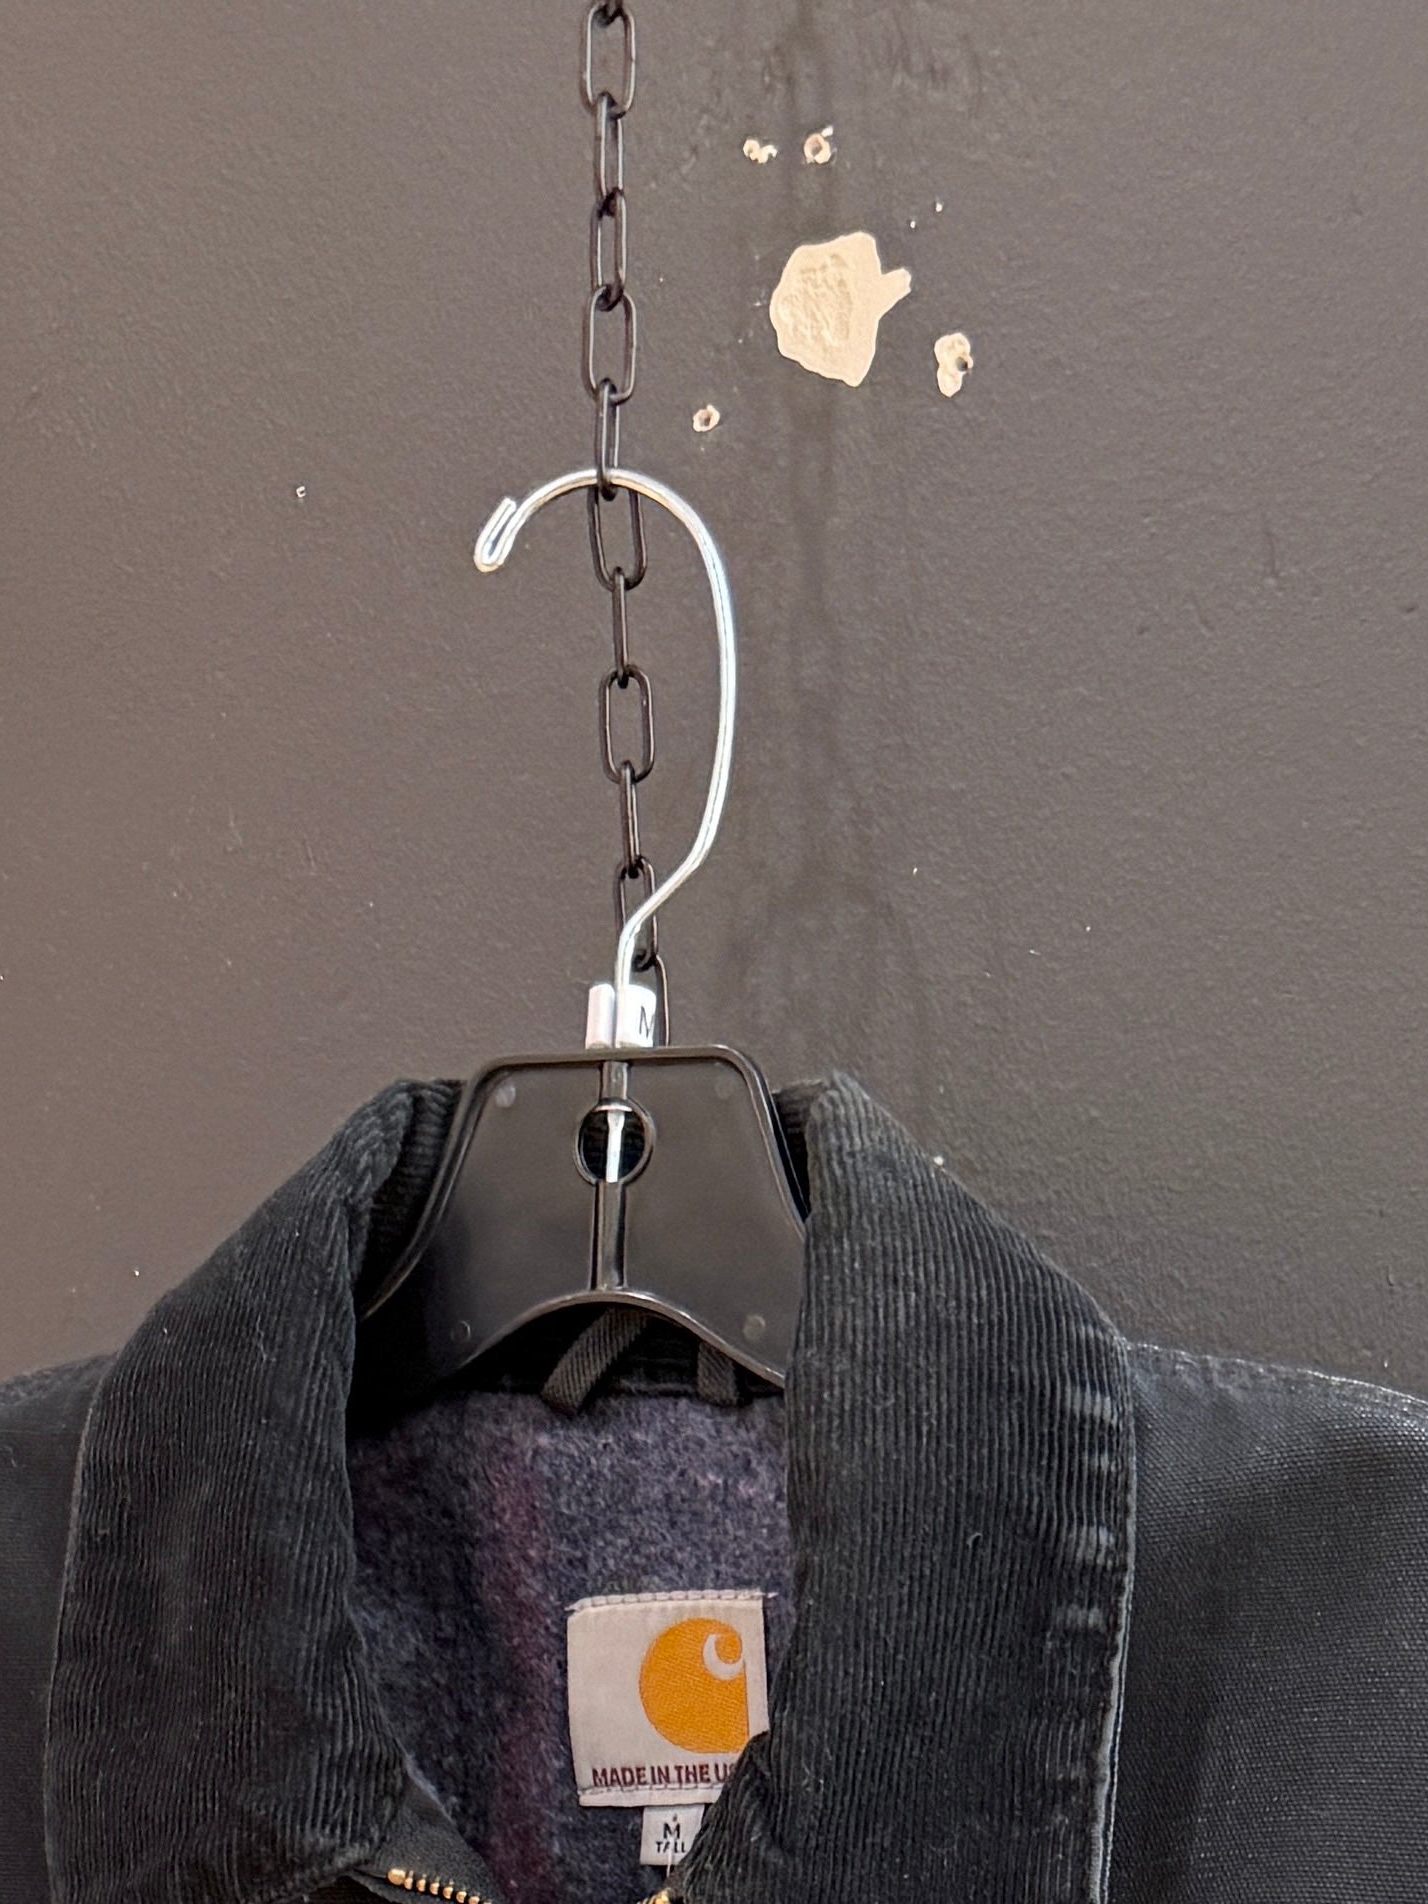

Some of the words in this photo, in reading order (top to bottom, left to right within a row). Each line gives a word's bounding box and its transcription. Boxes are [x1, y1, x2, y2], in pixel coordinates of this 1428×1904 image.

[592, 1765, 647, 1787] MADE
[650, 1764, 671, 1784] IN
[674, 1763, 711, 1784] THE
[663, 1822, 681, 1839] M
